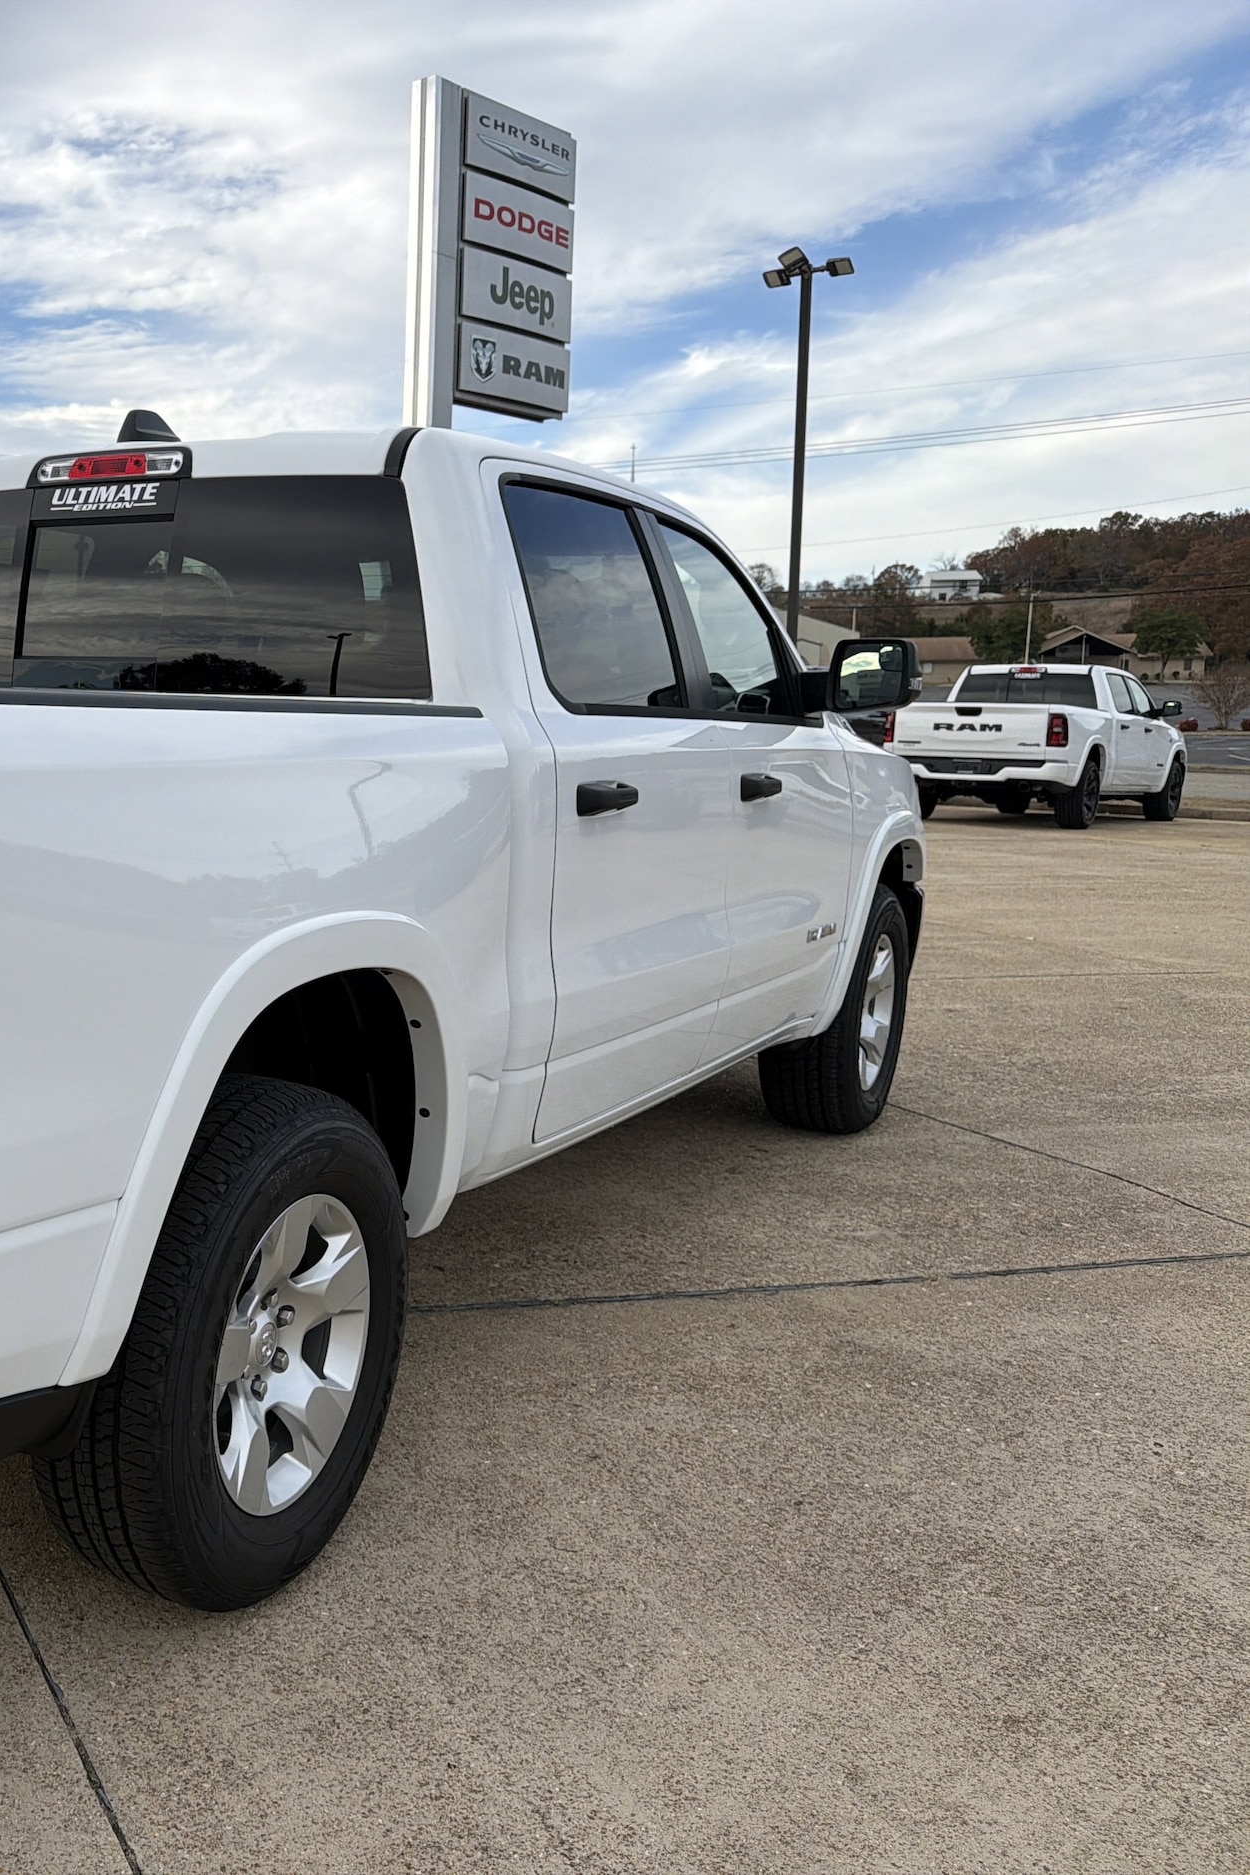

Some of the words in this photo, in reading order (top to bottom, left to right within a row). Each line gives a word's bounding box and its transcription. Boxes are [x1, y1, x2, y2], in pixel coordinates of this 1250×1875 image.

[479, 115, 570, 161] CHRYSLER
[474, 198, 569, 249] DODGE
[490, 266, 554, 325] Jeep
[502, 354, 565, 390] RAM
[52, 482, 160, 505] ULTIMATE
[73, 501, 134, 511] EDITION
[933, 723, 1003, 733] RAM
